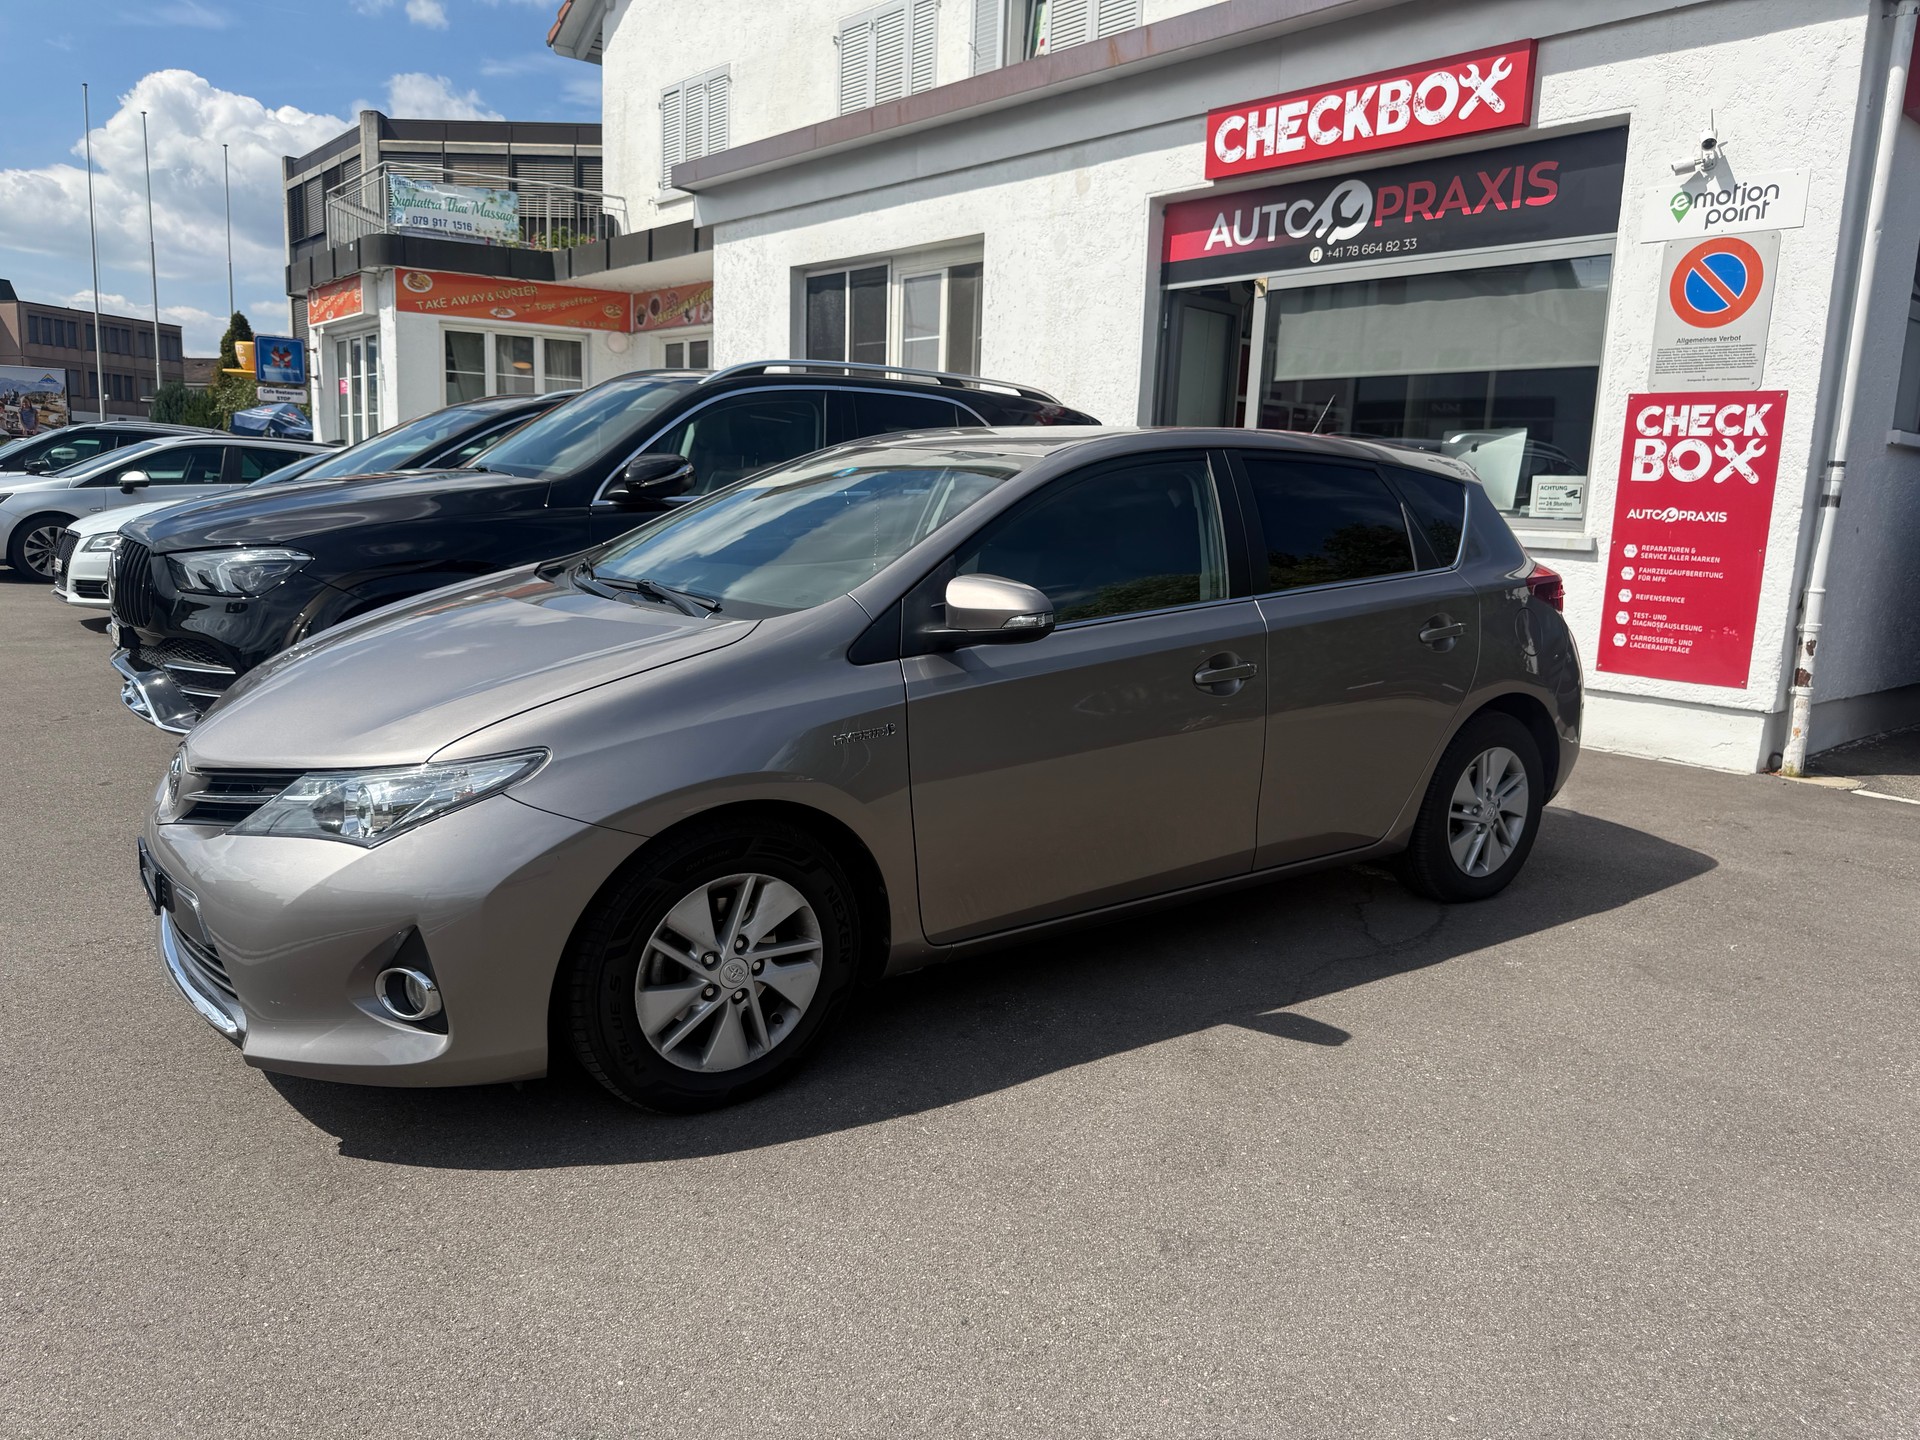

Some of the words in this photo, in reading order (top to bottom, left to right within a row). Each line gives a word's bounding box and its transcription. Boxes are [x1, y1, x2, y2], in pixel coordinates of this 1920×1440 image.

[1670, 182, 1780, 210] emotion
[444, 196, 468, 213] Thai
[471, 200, 517, 224] Massage
[1704, 199, 1770, 230] point
[412, 215, 429, 226] 079
[432, 217, 448, 228] 917
[452, 220, 473, 232] 1516
[1326, 247, 1343, 258] +41
[1346, 245, 1359, 257] 78
[1361, 242, 1383, 255] 664
[1385, 240, 1400, 252] 82
[1402, 238, 1417, 251] 33
[416, 297, 448, 311] TAKE
[534, 302, 556, 313] Tage
[1676, 335, 1717, 345] Allgemeines
[1718, 334, 1742, 343] Verbot
[1636, 403, 1773, 437] CHECK
[1641, 544, 1690, 554] REPARATUREN
[1640, 552, 1667, 560] SERVICE
[1668, 553, 1690, 562] ALLER
[1690, 555, 1721, 564] MARKEN
[1637, 574, 1651, 582] FÜR
[1652, 575, 1667, 583] MFK
[1638, 566, 1724, 579] FAHRZEUGAUFBEREITUNG
[1635, 593, 1686, 604] REIFENSERVICE
[1633, 611, 1651, 619] TEST-
[1652, 613, 1667, 621] UND
[1632, 619, 1703, 632] DIAGNOSEAUSLESUNG
[1630, 634, 1677, 644] CARROSSERIE-
[1678, 638, 1693, 647] UND
[1629, 642, 1690, 654] LACKIERAUFTRÄGE
[823, 885, 850, 963] NEXEN
